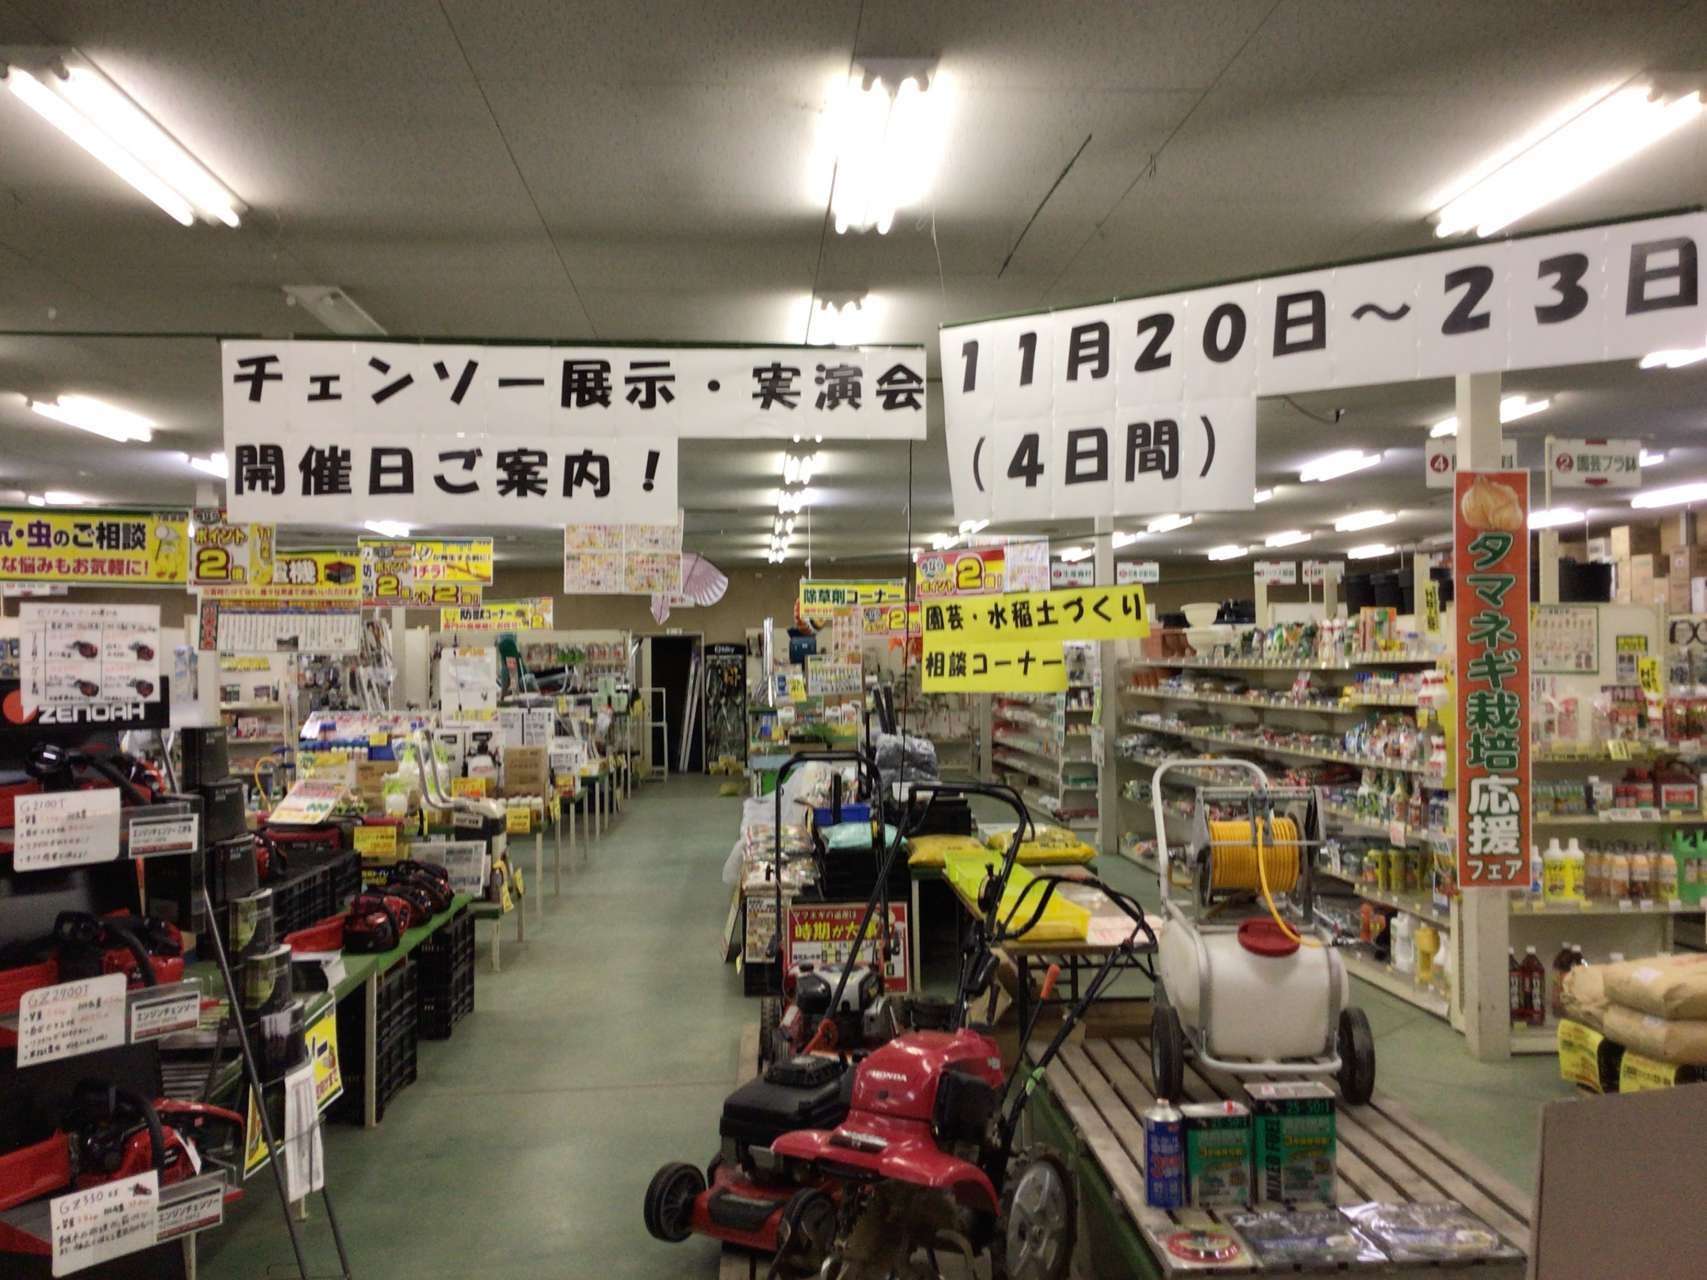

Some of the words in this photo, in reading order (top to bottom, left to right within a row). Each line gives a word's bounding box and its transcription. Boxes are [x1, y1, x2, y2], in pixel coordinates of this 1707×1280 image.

[233, 354, 924, 411] チェンソー展示・実演会
[926, 651, 1063, 678] 相談コーナー
[1466, 859, 1523, 881] フェア
[871, 1070, 907, 1082] HONDA
